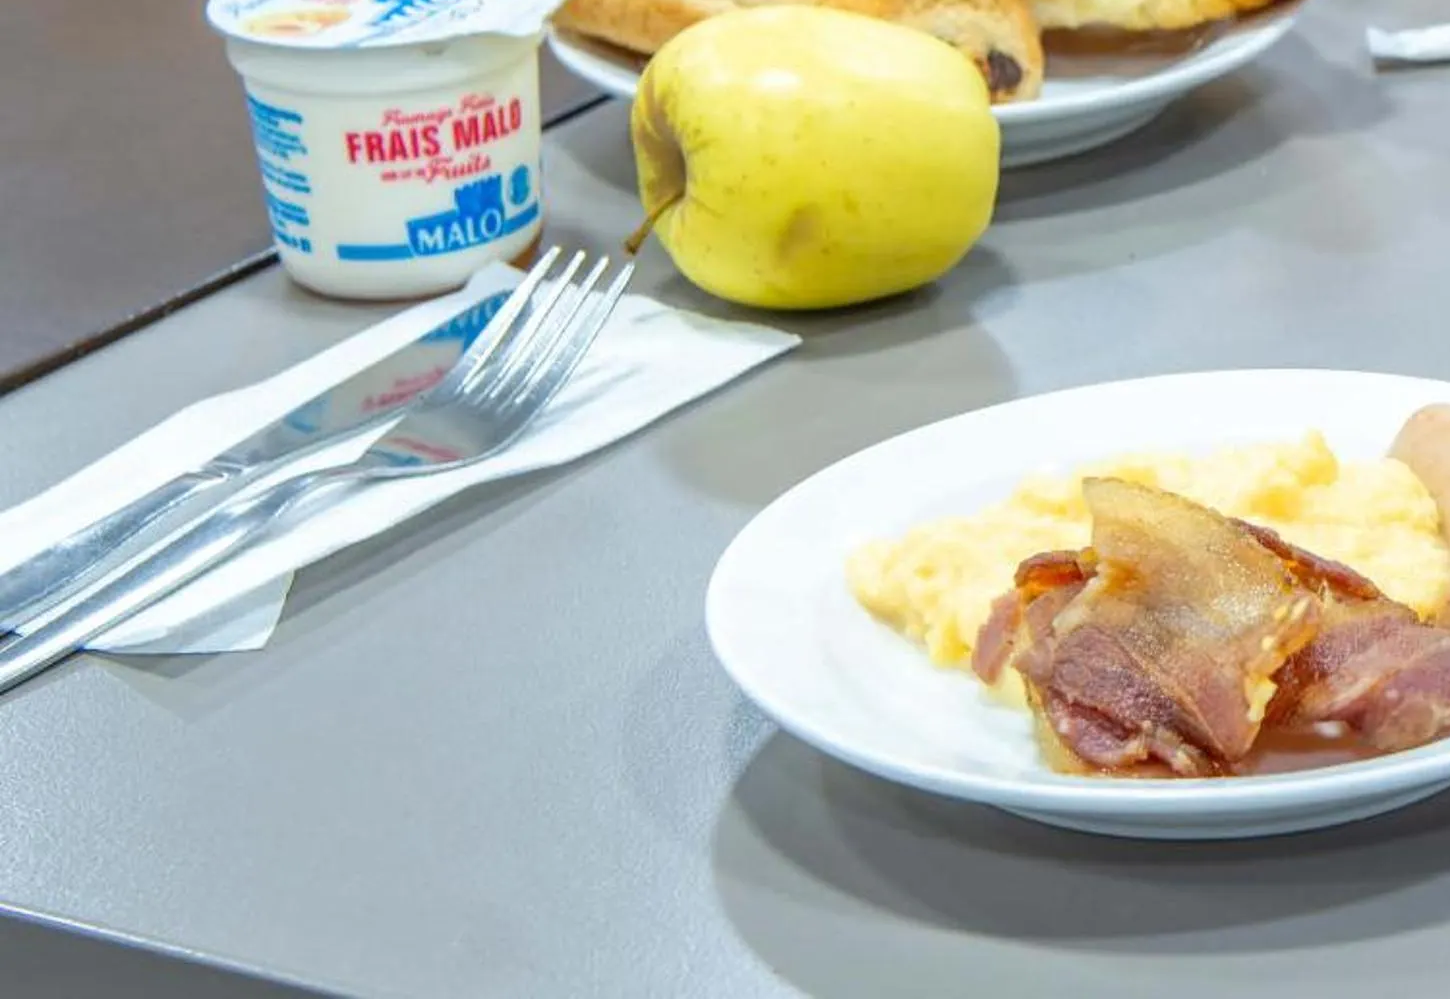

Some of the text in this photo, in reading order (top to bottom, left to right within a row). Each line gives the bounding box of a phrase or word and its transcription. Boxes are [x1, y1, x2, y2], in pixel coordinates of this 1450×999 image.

[345, 98, 521, 164] FRAIS MALO
[415, 207, 502, 253] MALO
